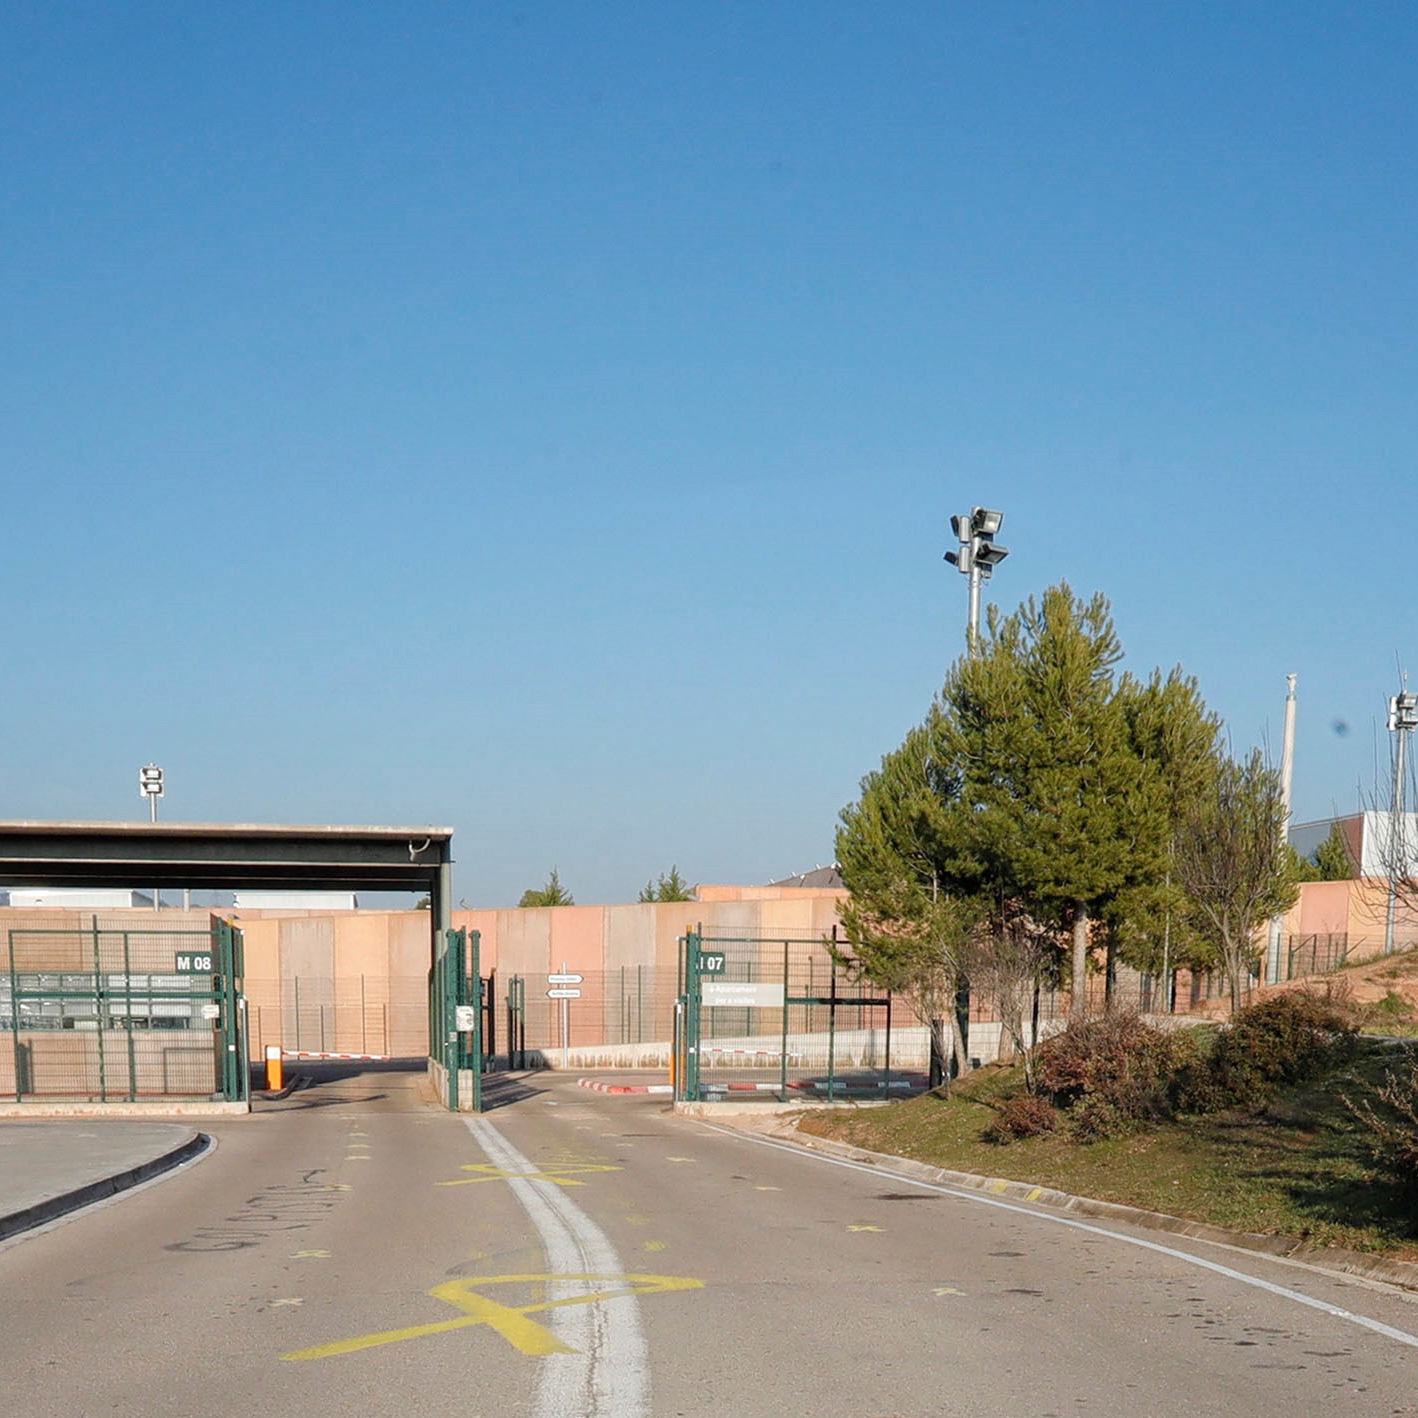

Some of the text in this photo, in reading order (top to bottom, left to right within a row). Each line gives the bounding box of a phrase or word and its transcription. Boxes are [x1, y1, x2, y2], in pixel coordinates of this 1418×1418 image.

[177, 956, 211, 970] M 08
[707, 956, 723, 970] 07
